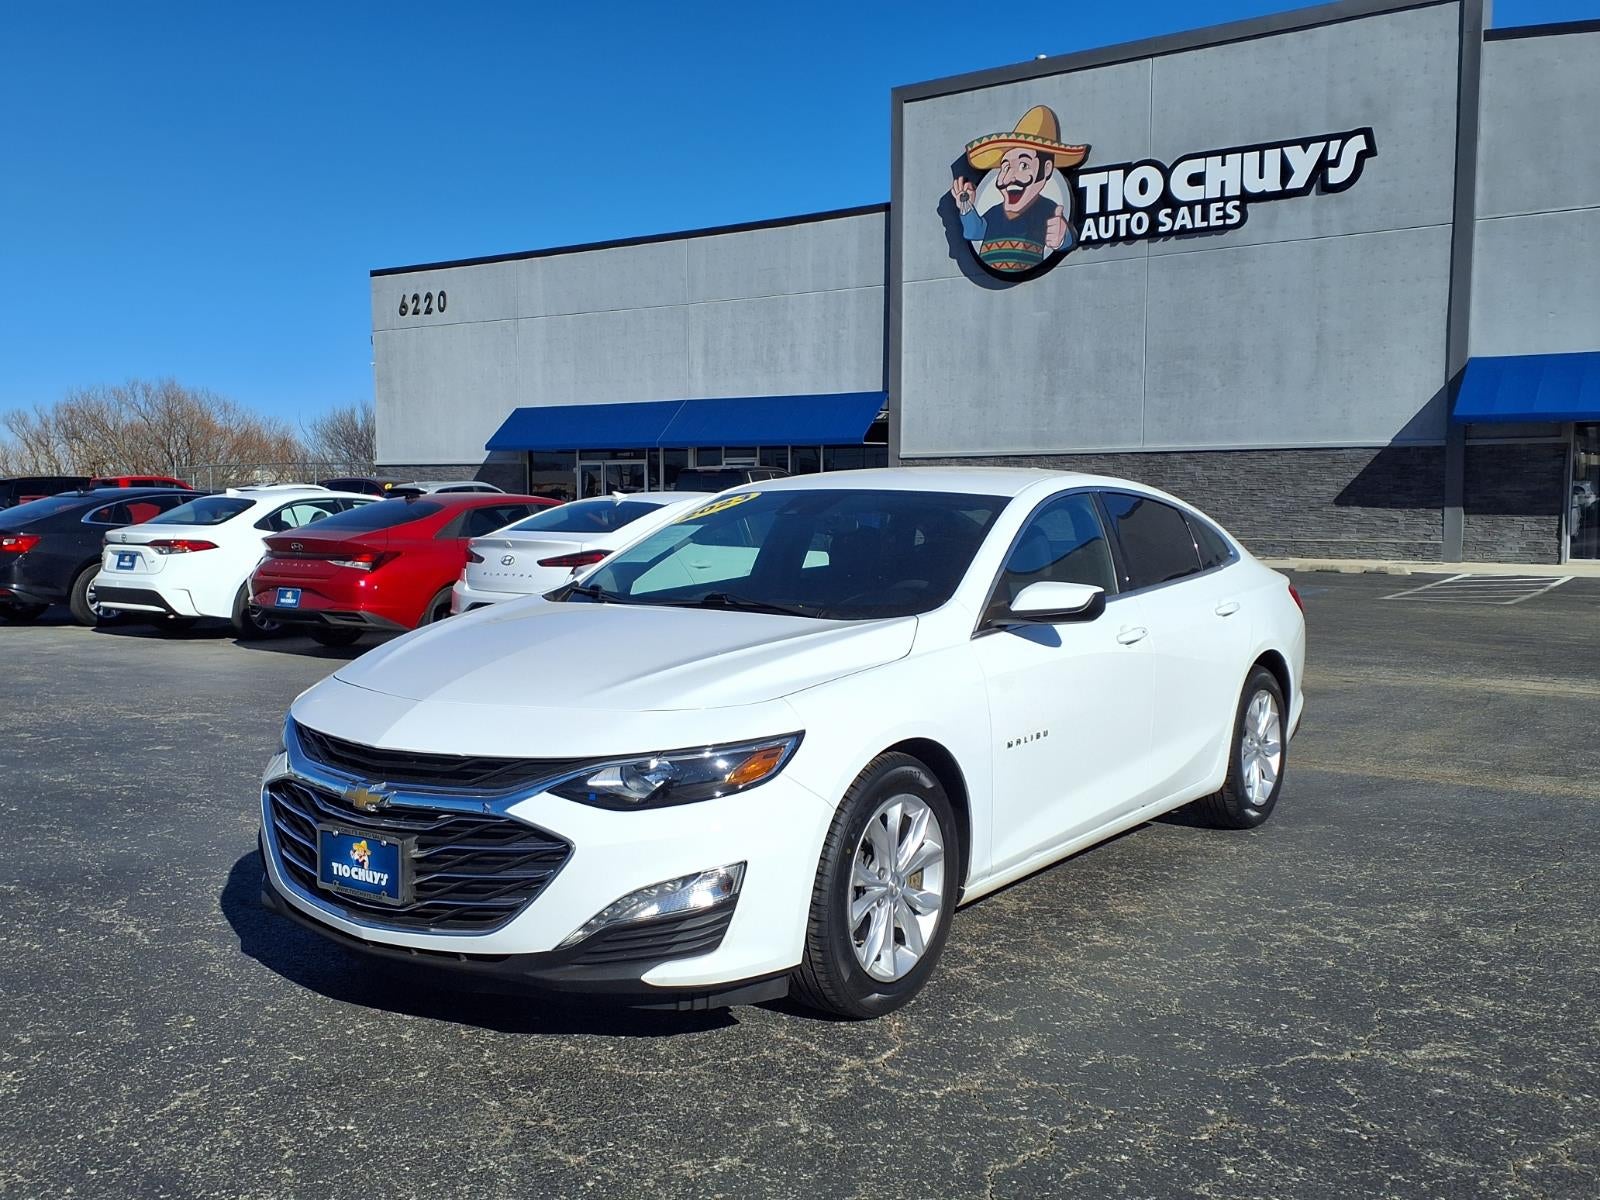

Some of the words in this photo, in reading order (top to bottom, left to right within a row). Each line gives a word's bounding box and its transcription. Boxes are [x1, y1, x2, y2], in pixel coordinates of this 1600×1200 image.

[1078, 165, 1165, 214] TIO
[1169, 134, 1367, 202] CHUY'S
[1079, 213, 1150, 242] AUTO
[1158, 200, 1242, 233] SALES
[398, 290, 447, 317] 6220
[1006, 729, 1049, 749] MALIBU
[331, 861, 351, 878] TIO
[350, 866, 389, 886] CHUY'S
